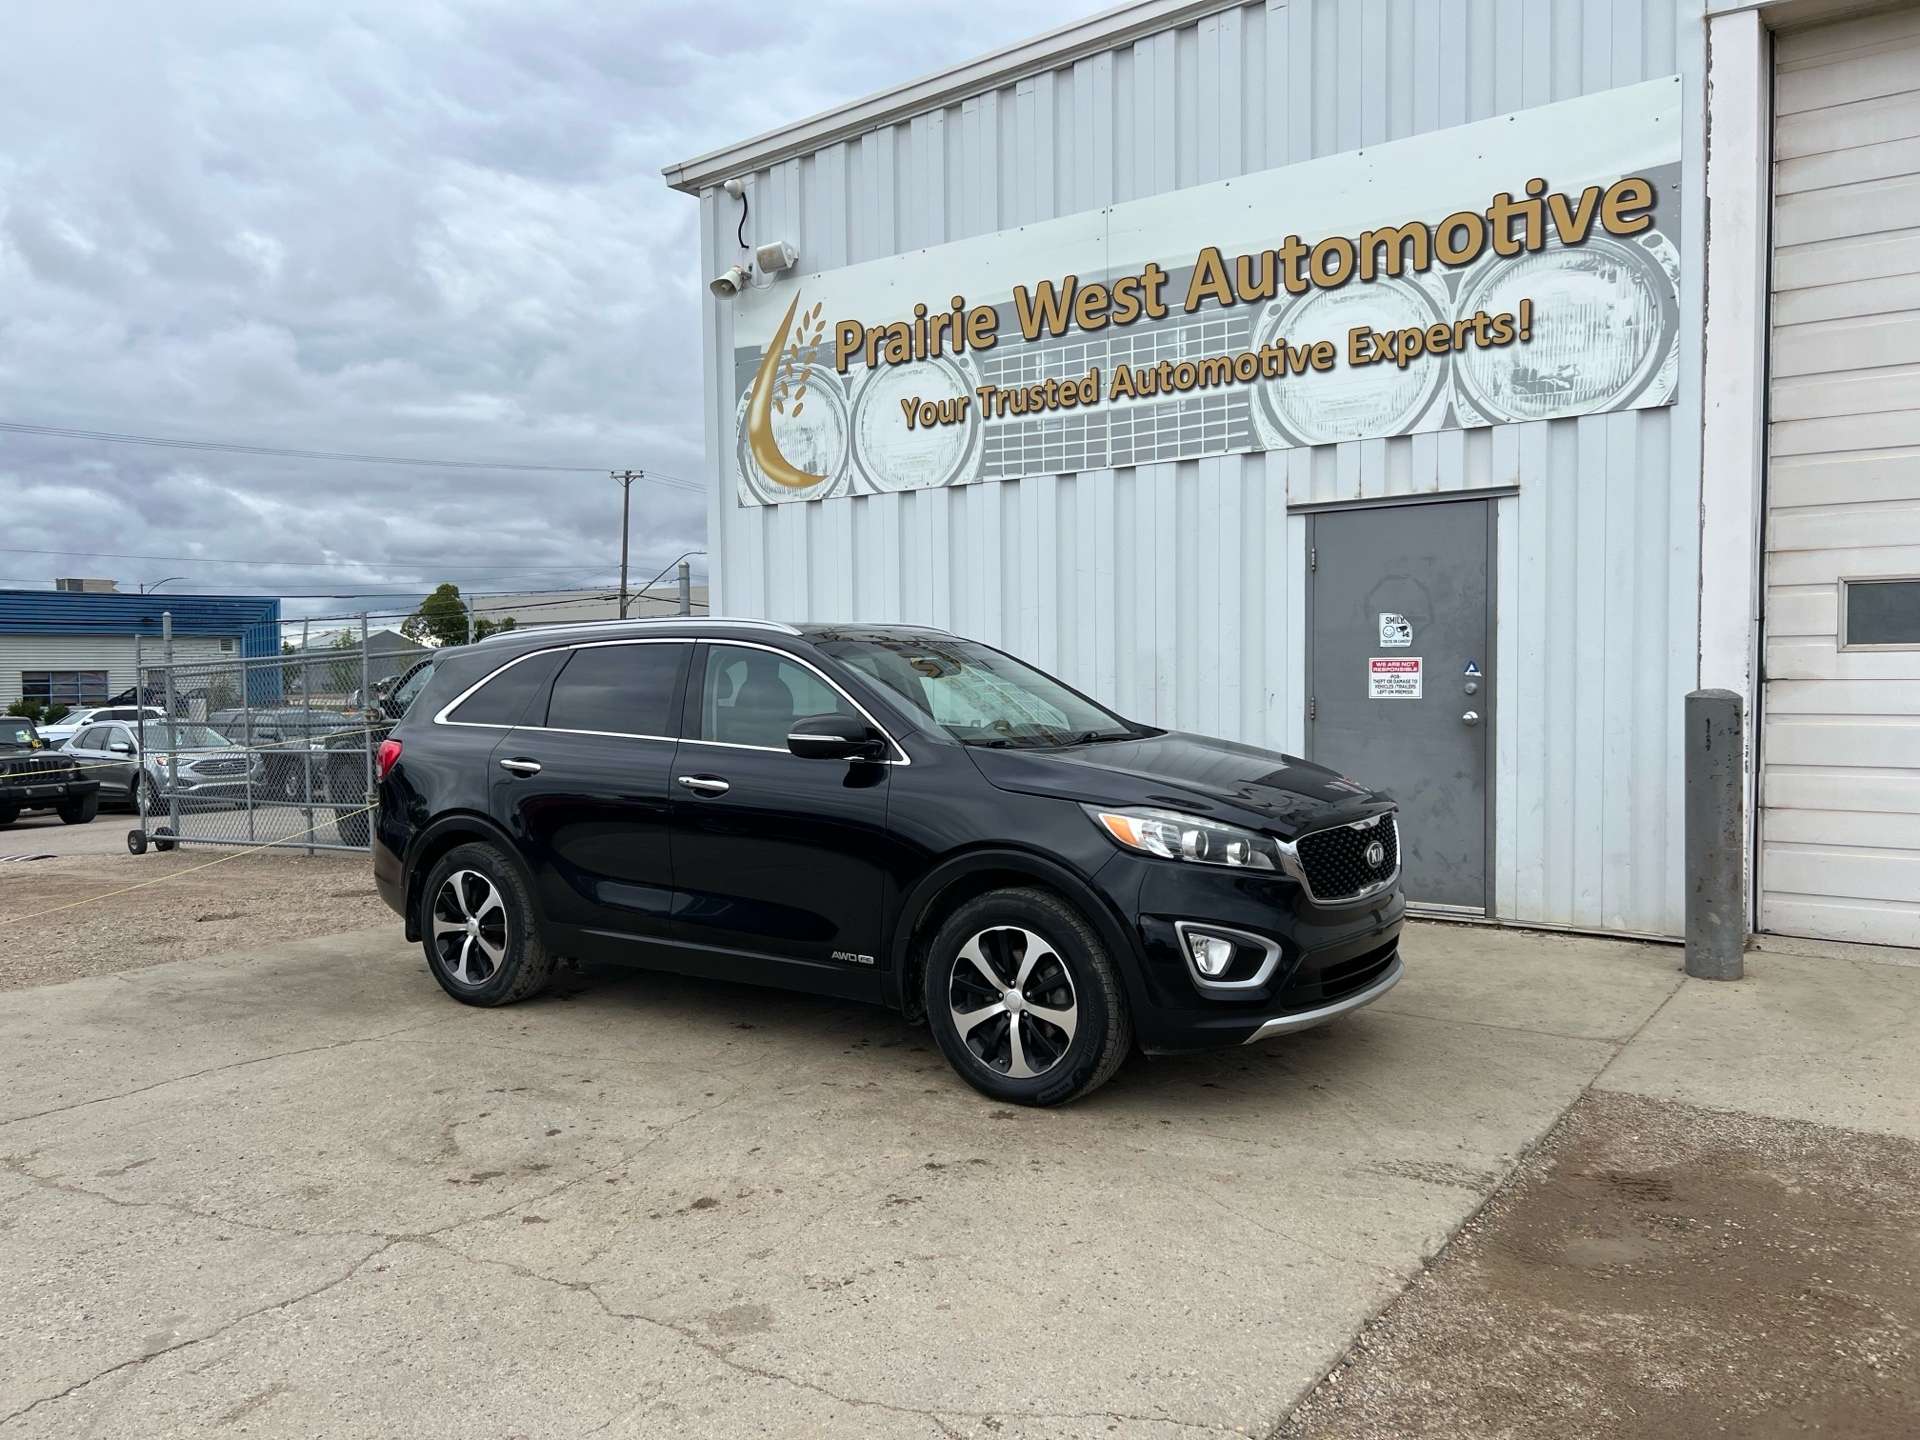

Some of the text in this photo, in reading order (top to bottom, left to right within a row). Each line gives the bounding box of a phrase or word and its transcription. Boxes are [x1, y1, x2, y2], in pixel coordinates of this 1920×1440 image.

[834, 178, 1655, 372] Prairie West Automotive
[900, 299, 1533, 430] Your Trusted Automotive Experts!
[831, 951, 858, 962] AWD
